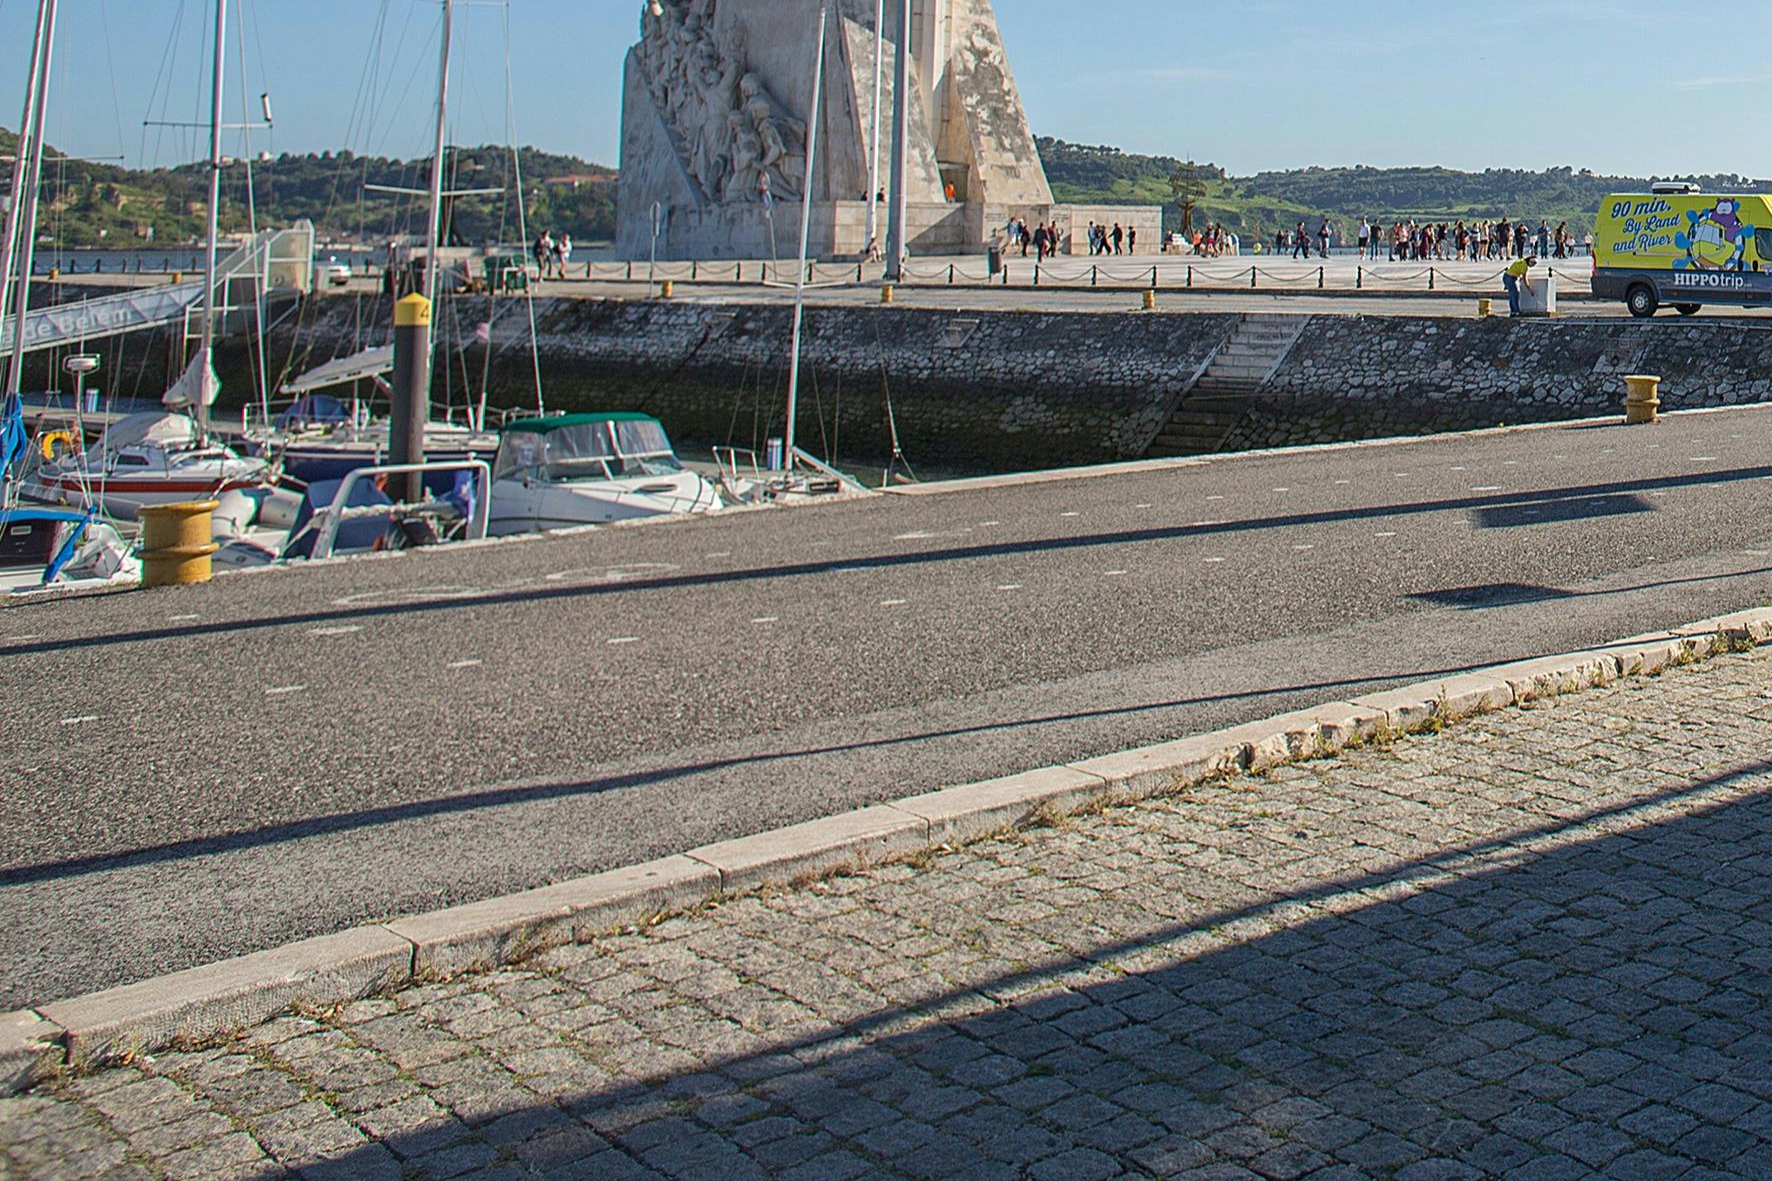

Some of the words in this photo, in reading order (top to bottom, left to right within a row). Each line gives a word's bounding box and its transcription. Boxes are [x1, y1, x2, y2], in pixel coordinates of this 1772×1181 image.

[1611, 201, 1631, 218] 90
[1634, 197, 1672, 215] min.
[1623, 218, 1642, 235] By
[1644, 213, 1680, 232] Land
[1613, 237, 1636, 251] and
[1639, 234, 1671, 251] River
[1674, 273, 1744, 289] HIPPOtrip
